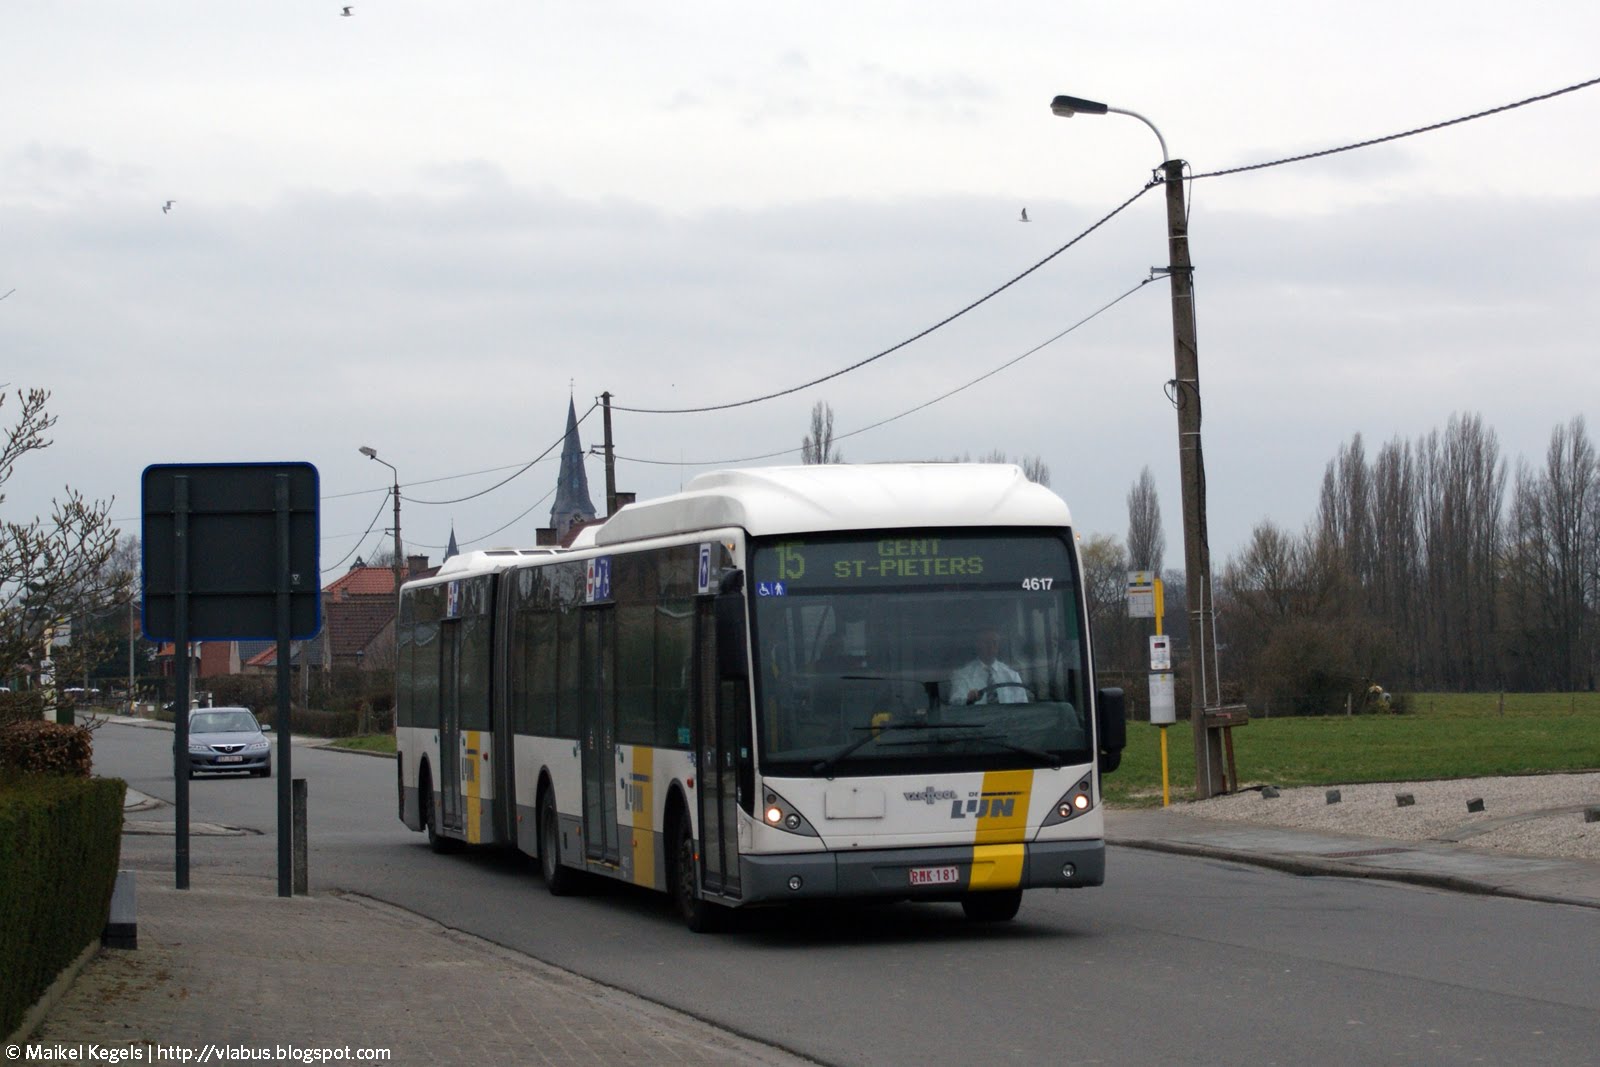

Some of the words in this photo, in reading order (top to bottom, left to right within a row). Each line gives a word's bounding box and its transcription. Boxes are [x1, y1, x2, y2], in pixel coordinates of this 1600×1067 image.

[877, 538, 941, 557] GENT
[776, 541, 805, 579] 15
[834, 557, 983, 579] ST-PIETERS
[1021, 578, 1053, 592] 4617
